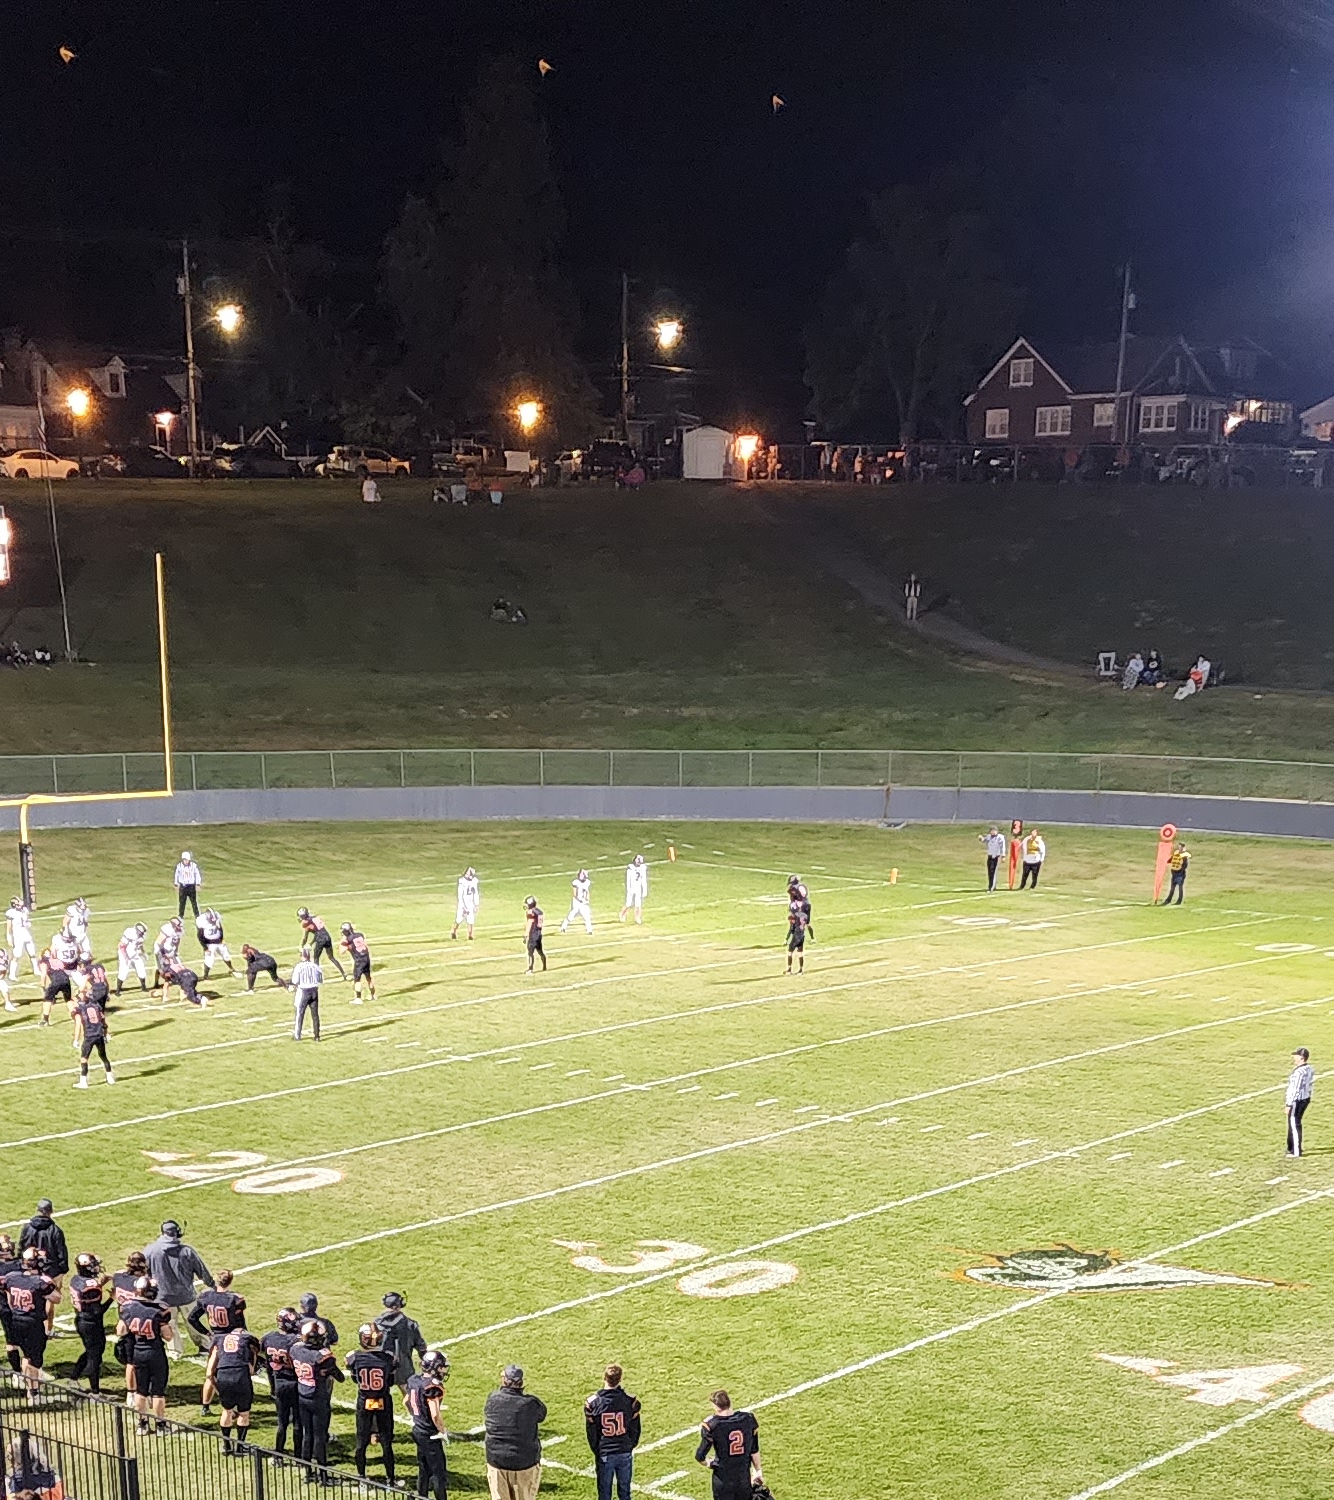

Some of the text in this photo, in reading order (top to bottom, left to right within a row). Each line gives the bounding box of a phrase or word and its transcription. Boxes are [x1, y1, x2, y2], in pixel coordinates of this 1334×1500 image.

[148, 1150, 346, 1195] 20
[569, 1238, 799, 1299] 30
[10, 1286, 36, 1313] 72
[128, 1317, 156, 1340] 44
[206, 1304, 230, 1328] 10
[223, 1334, 239, 1353] 6
[358, 1368, 384, 1391] 16
[600, 1412, 627, 1437] 51
[728, 1429, 745, 1456] 2
